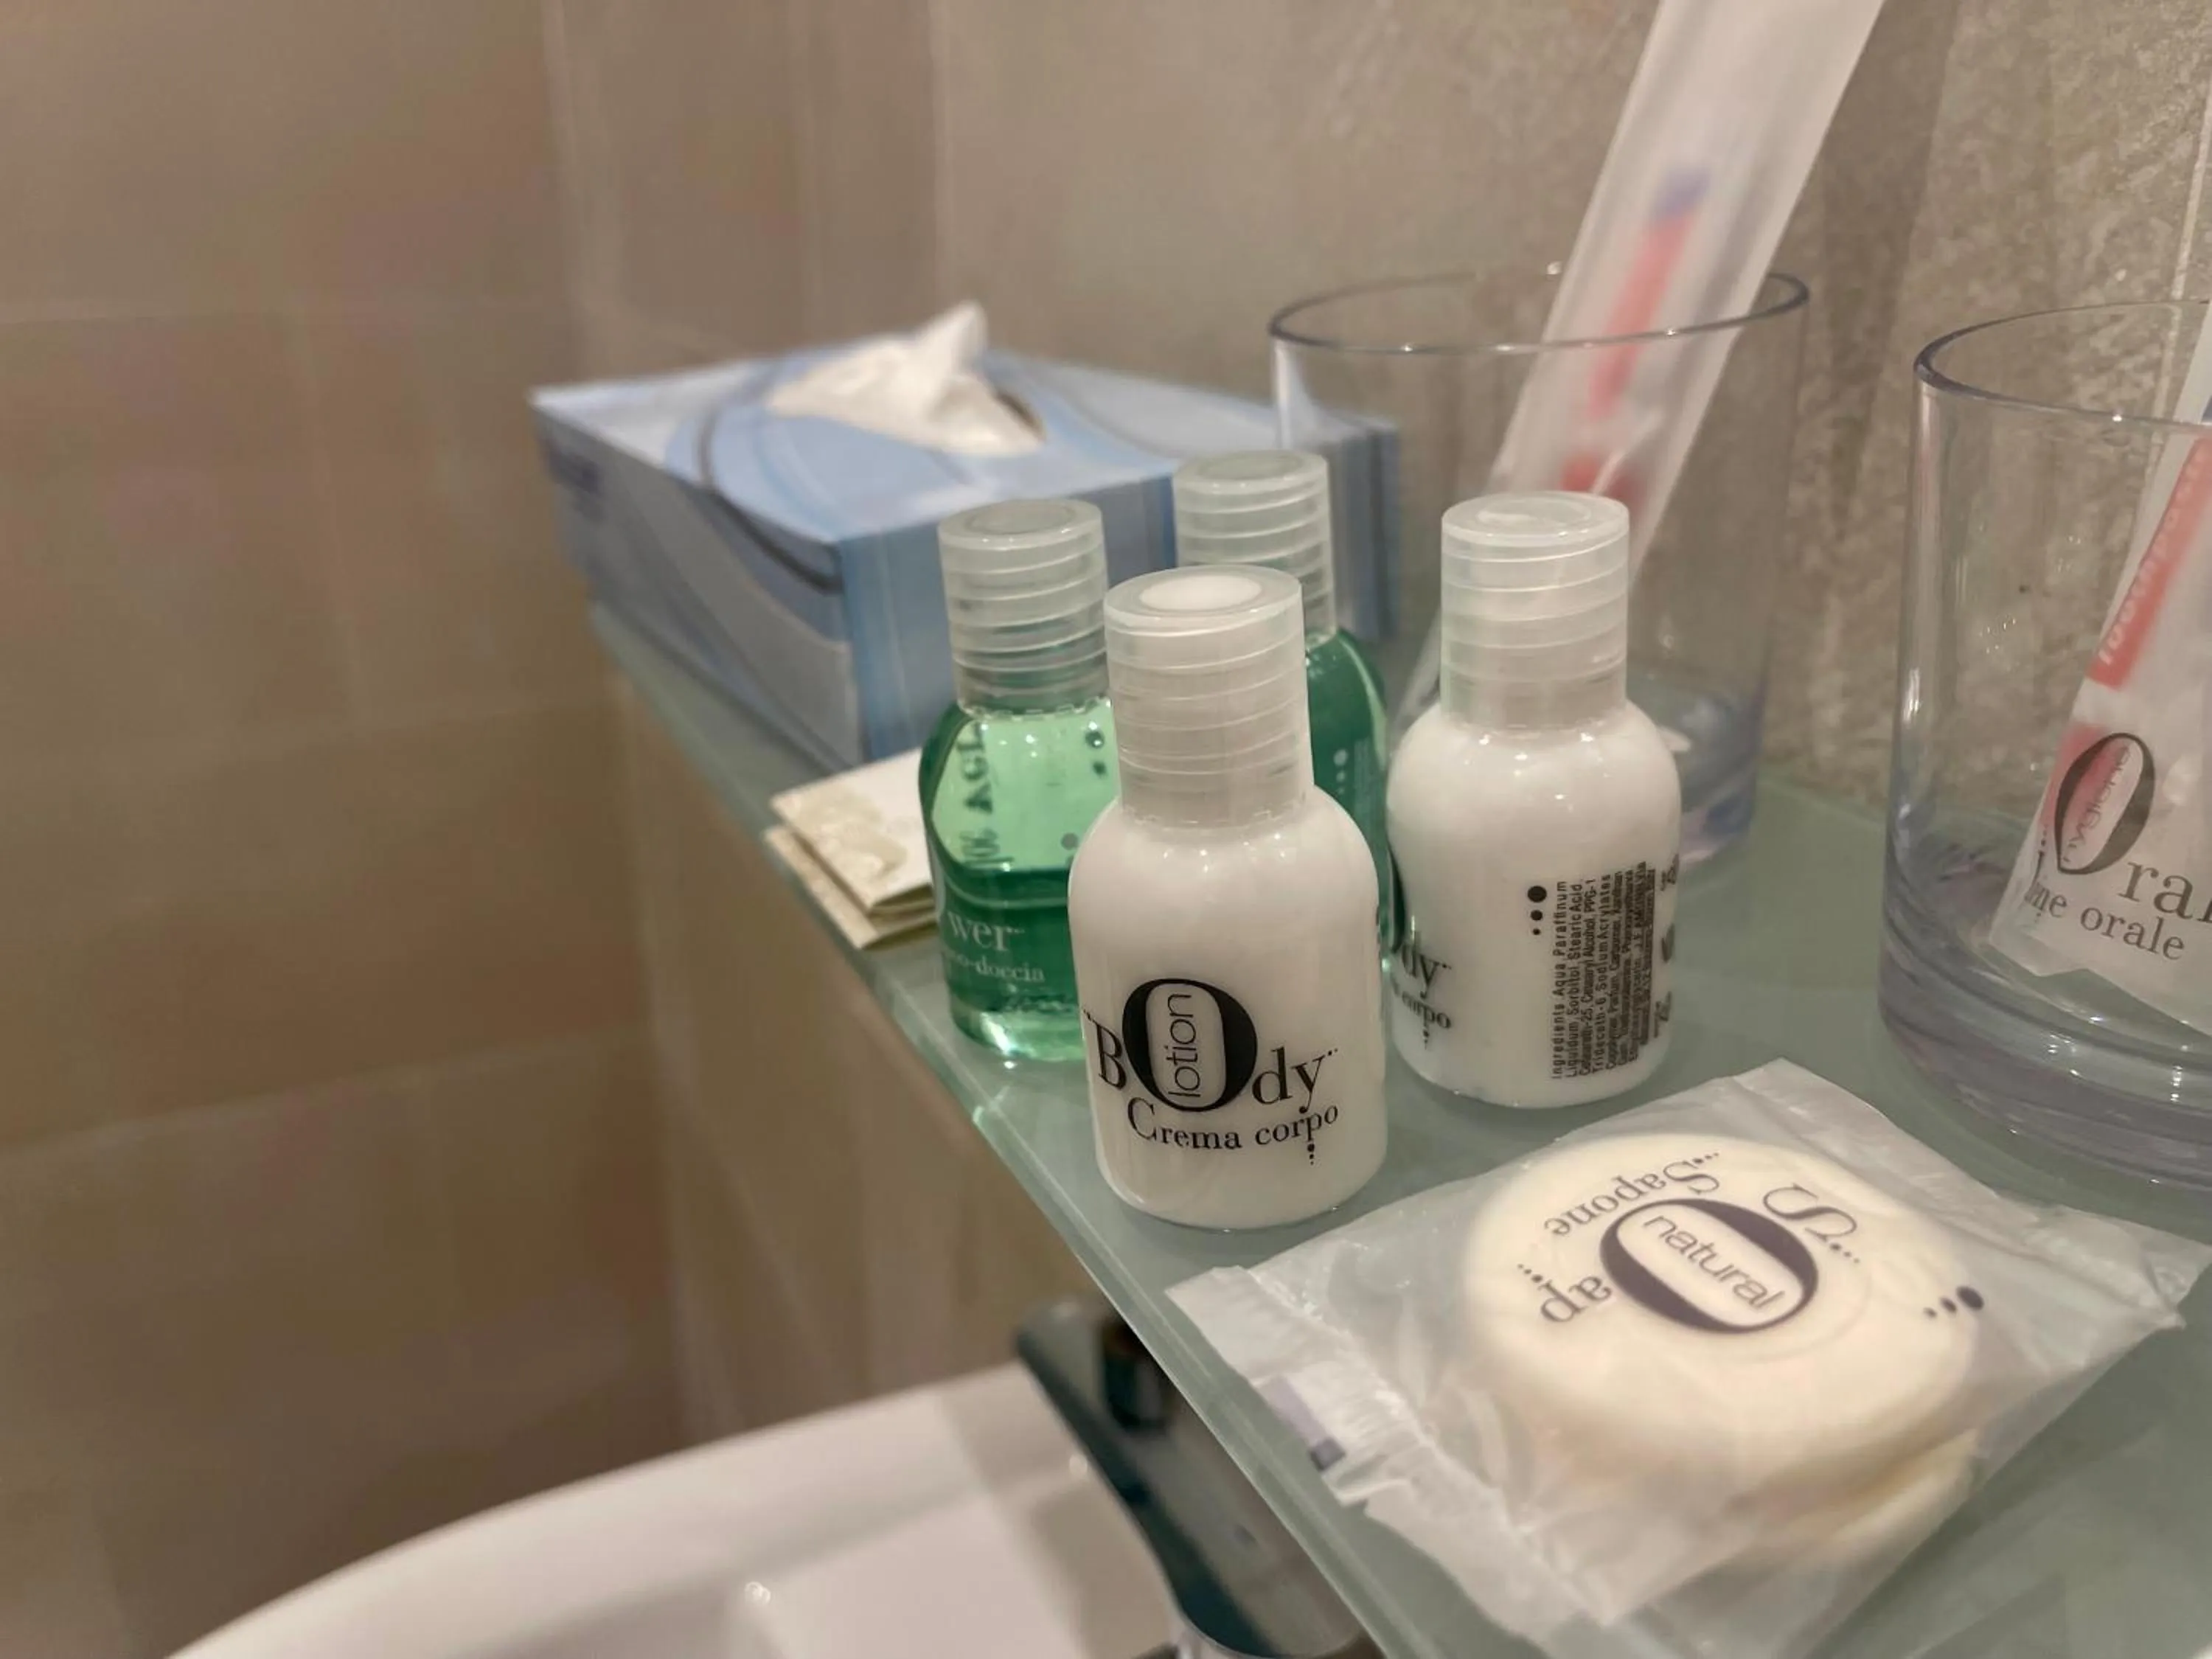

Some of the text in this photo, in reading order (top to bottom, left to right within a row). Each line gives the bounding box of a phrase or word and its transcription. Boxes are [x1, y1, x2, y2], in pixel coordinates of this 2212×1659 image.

[2080, 906, 2185, 960] orale
[1167, 992, 1201, 1099] lotion
[1127, 1096, 1338, 1150] Crema corpo
[1544, 1160, 1720, 1237] Sapone
[1642, 1214, 1785, 1309] natural
